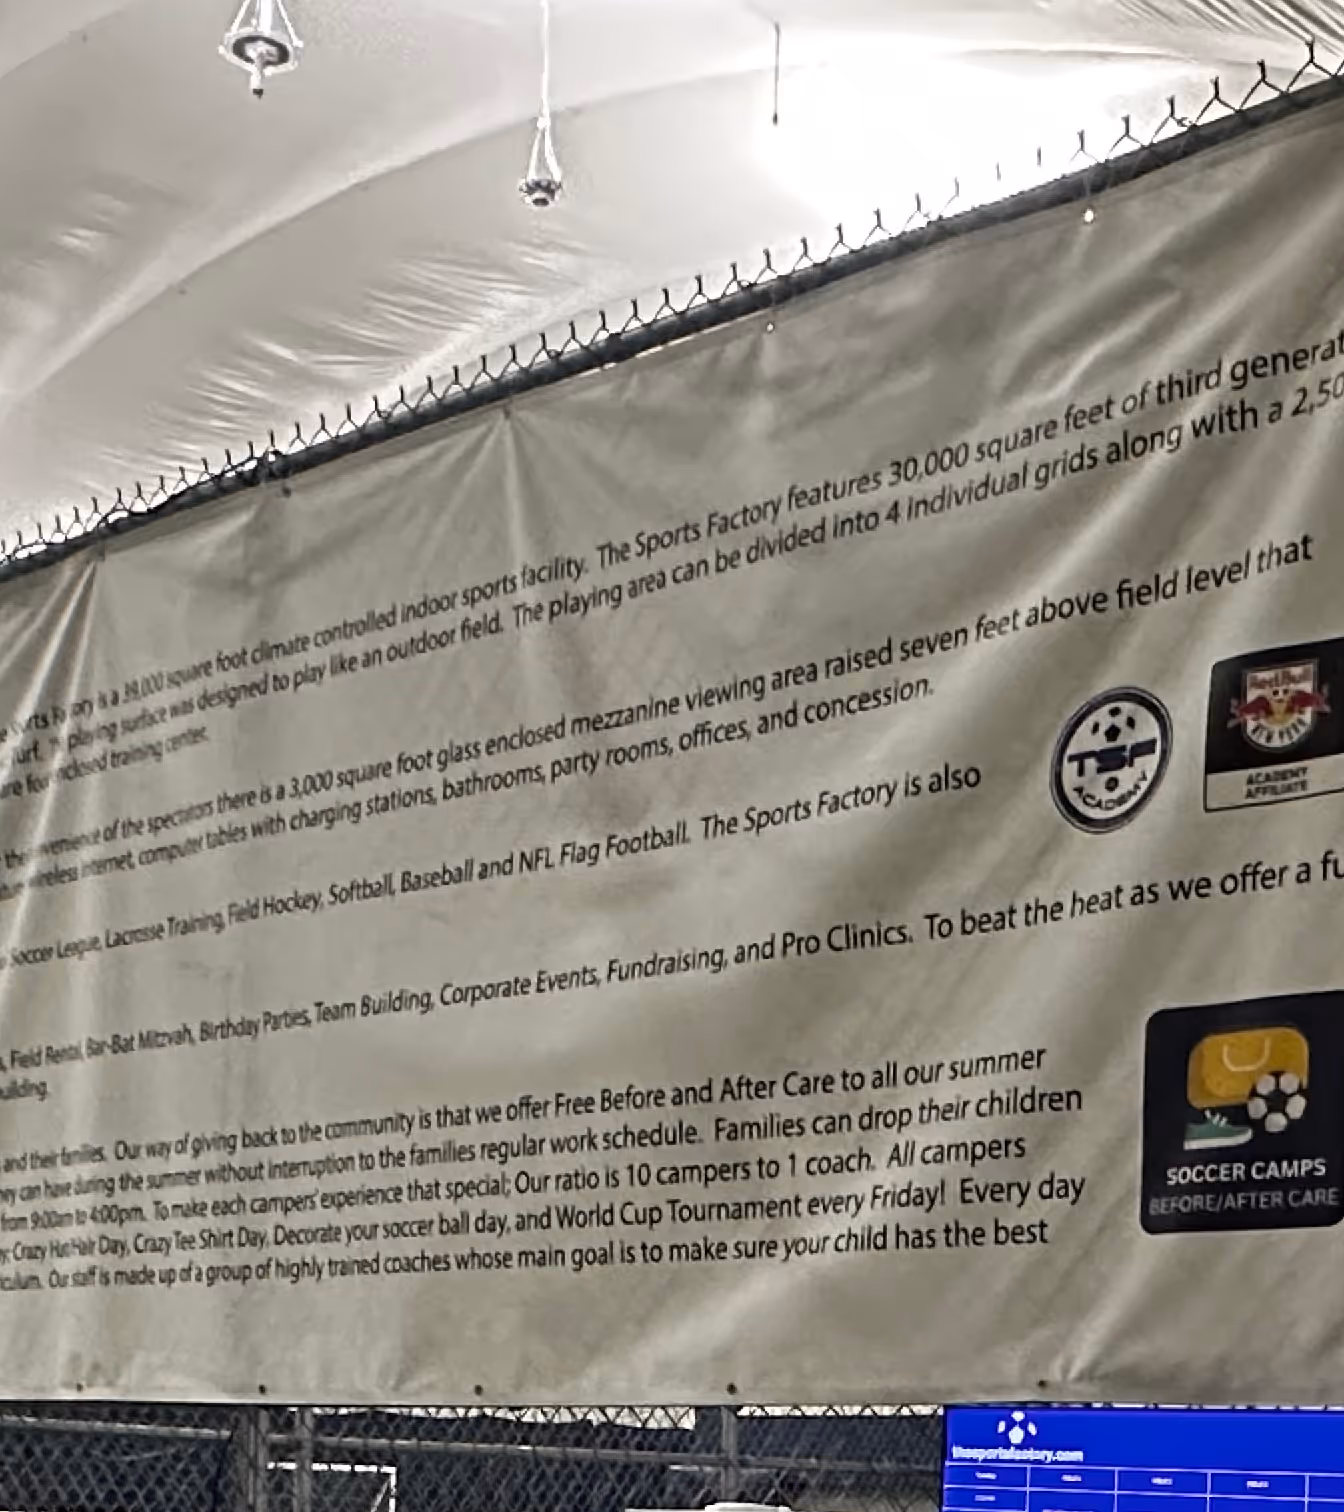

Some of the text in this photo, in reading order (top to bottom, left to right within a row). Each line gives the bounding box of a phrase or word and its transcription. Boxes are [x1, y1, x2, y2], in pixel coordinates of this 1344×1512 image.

[462, 575, 517, 609] sports
[596, 542, 631, 569] The
[635, 523, 701, 560] Sports
[707, 496, 782, 537] Factory
[788, 472, 881, 511] features
[889, 442, 969, 487] 30,000
[975, 419, 1058, 463] square
[1065, 395, 1115, 432] feet
[1121, 382, 1151, 415] of
[1156, 362, 1221, 405] third
[512, 602, 544, 629] The
[549, 585, 622, 623] playing
[628, 570, 666, 599] area
[672, 559, 709, 584] can
[715, 549, 741, 573] be
[746, 518, 826, 564] divided
[833, 511, 879, 538] into
[885, 500, 900, 523] 4
[907, 462, 1028, 520] individual
[1035, 445, 1098, 490] grids
[1106, 425, 1183, 465] along
[1191, 401, 1257, 438] with
[1267, 401, 1283, 424] a
[397, 535, 1312, 774] foot glass enclosed mezzanine viewing area raised seven feet above field level that
[551, 751, 599, 784] party
[605, 737, 673, 766] rooms,
[679, 720, 751, 751] offices,
[757, 705, 798, 734] and
[804, 679, 933, 724] concession.
[1247, 766, 1308, 785] ACADEMY
[401, 767, 981, 893] Baseball and NFL Flag Football. The Sports Factory is also
[440, 977, 531, 1007] Corporate
[607, 949, 727, 983] Fundraising,
[734, 937, 775, 963] and
[782, 934, 820, 957] Pro
[827, 922, 913, 951] Clinics.
[924, 914, 953, 939] To
[961, 905, 1017, 935] beat
[1025, 899, 1063, 927] the
[1071, 887, 1123, 918] heat
[1130, 883, 1159, 905] as
[1167, 877, 1212, 900] we
[1220, 863, 1289, 895] offer
[1295, 863, 1311, 883] a
[475, 1049, 1046, 1124] we offer Free Before and After Care to all our summer
[481, 1088, 1081, 1165] regular work schedule. Families can drop their children
[515, 1137, 1025, 1194] Our ratio is 10 campers to 1 coach. All campers
[1149, 1187, 1340, 1216] BEFORE/AFTER CARE
[1166, 1158, 1327, 1186] SOCCER CAMPS
[438, 1210, 469, 1235] ball
[515, 1208, 551, 1231] and
[555, 1205, 615, 1229] World
[620, 1203, 663, 1230] Cup
[666, 1195, 802, 1223] Tournament
[807, 1194, 865, 1218] every
[871, 1182, 945, 1213] Friday!
[961, 1180, 1031, 1208] Every
[1038, 1173, 1085, 1205] day
[517, 1219, 1048, 1272] main goal is to make sure your child has the best
